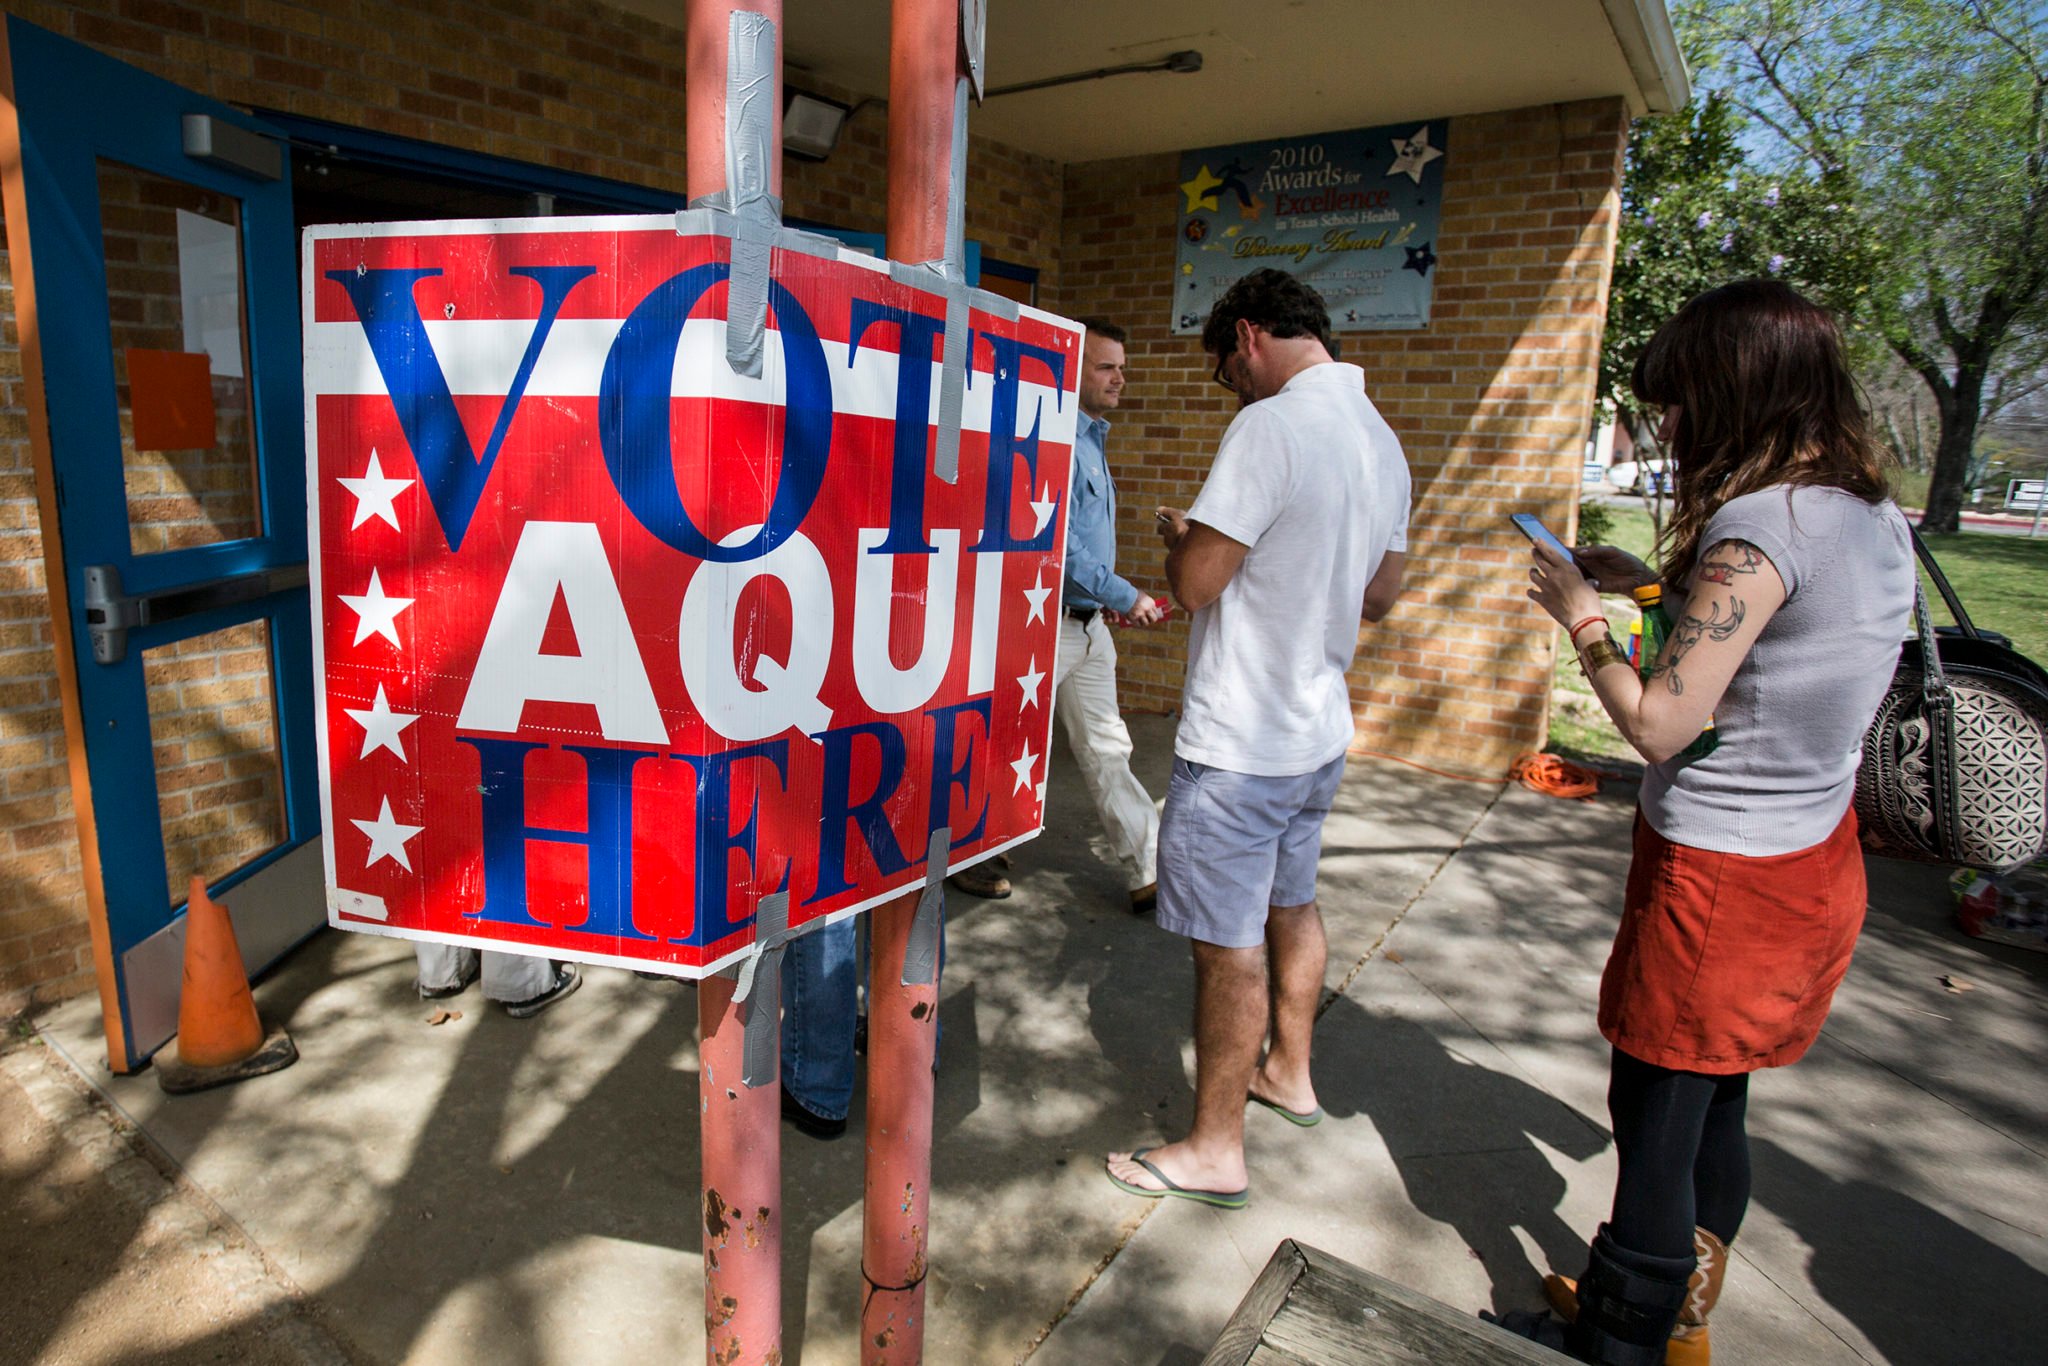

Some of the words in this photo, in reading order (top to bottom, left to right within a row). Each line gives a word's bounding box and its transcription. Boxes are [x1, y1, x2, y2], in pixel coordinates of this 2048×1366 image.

[1270, 143, 1325, 170] 2010
[1259, 160, 1343, 193] Awards
[1274, 187, 1390, 217] Excellence
[1275, 218, 1287, 230] in
[1289, 216, 1319, 229] Texas
[1320, 211, 1359, 227] School
[1361, 207, 1400, 224] Health
[1315, 228, 1391, 254] Award
[325, 262, 1066, 563] VOTE
[455, 521, 1005, 745] AQUI
[457, 697, 993, 947] HERE
